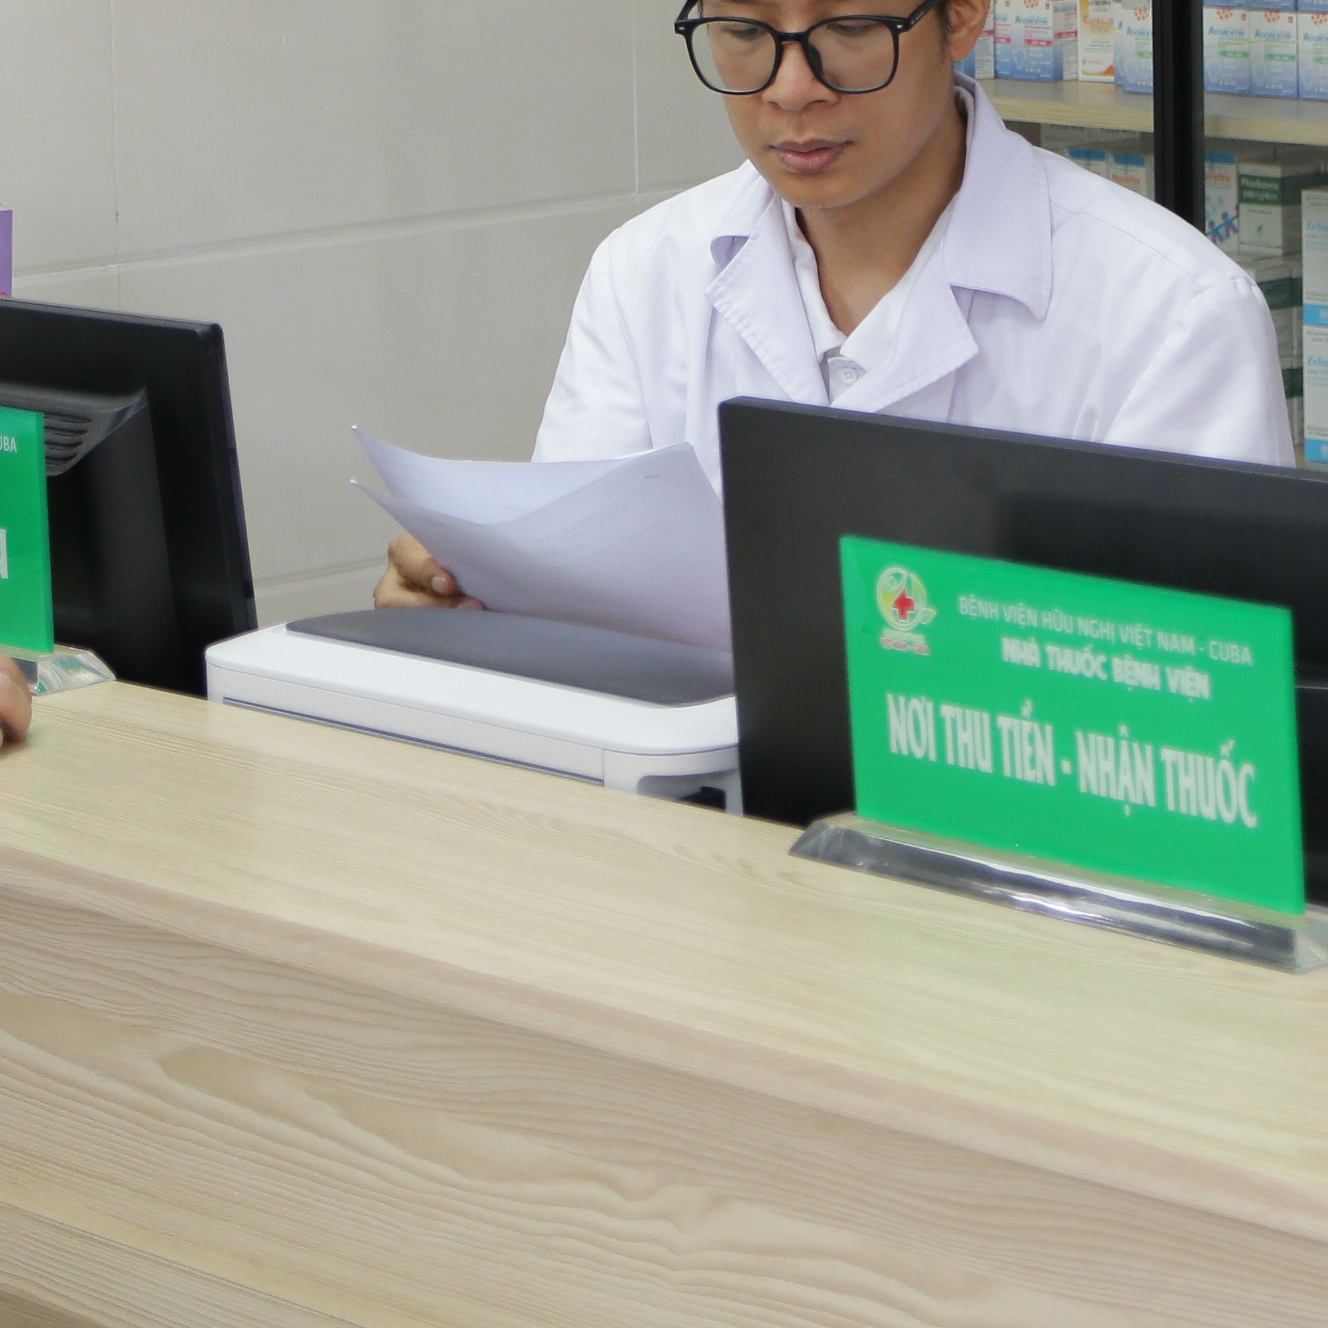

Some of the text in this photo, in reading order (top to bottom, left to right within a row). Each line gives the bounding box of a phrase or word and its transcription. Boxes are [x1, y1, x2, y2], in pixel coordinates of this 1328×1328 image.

[958, 594, 1000, 622] BỆNH
[1002, 600, 1038, 631] VIỆN
[1077, 616, 1117, 648] NGHỊ
[1118, 622, 1153, 650] VIỆT
[1156, 632, 1197, 657] NAM
[1208, 640, 1253, 667] CUBA
[1001, 635, 1211, 703] NHÀ THUỐC BỆNH VIỆN
[885, 692, 938, 762] NƠI
[940, 702, 993, 774] THU
[1075, 723, 1157, 818] NHẬN
[1160, 738, 1260, 829] THUỐC
